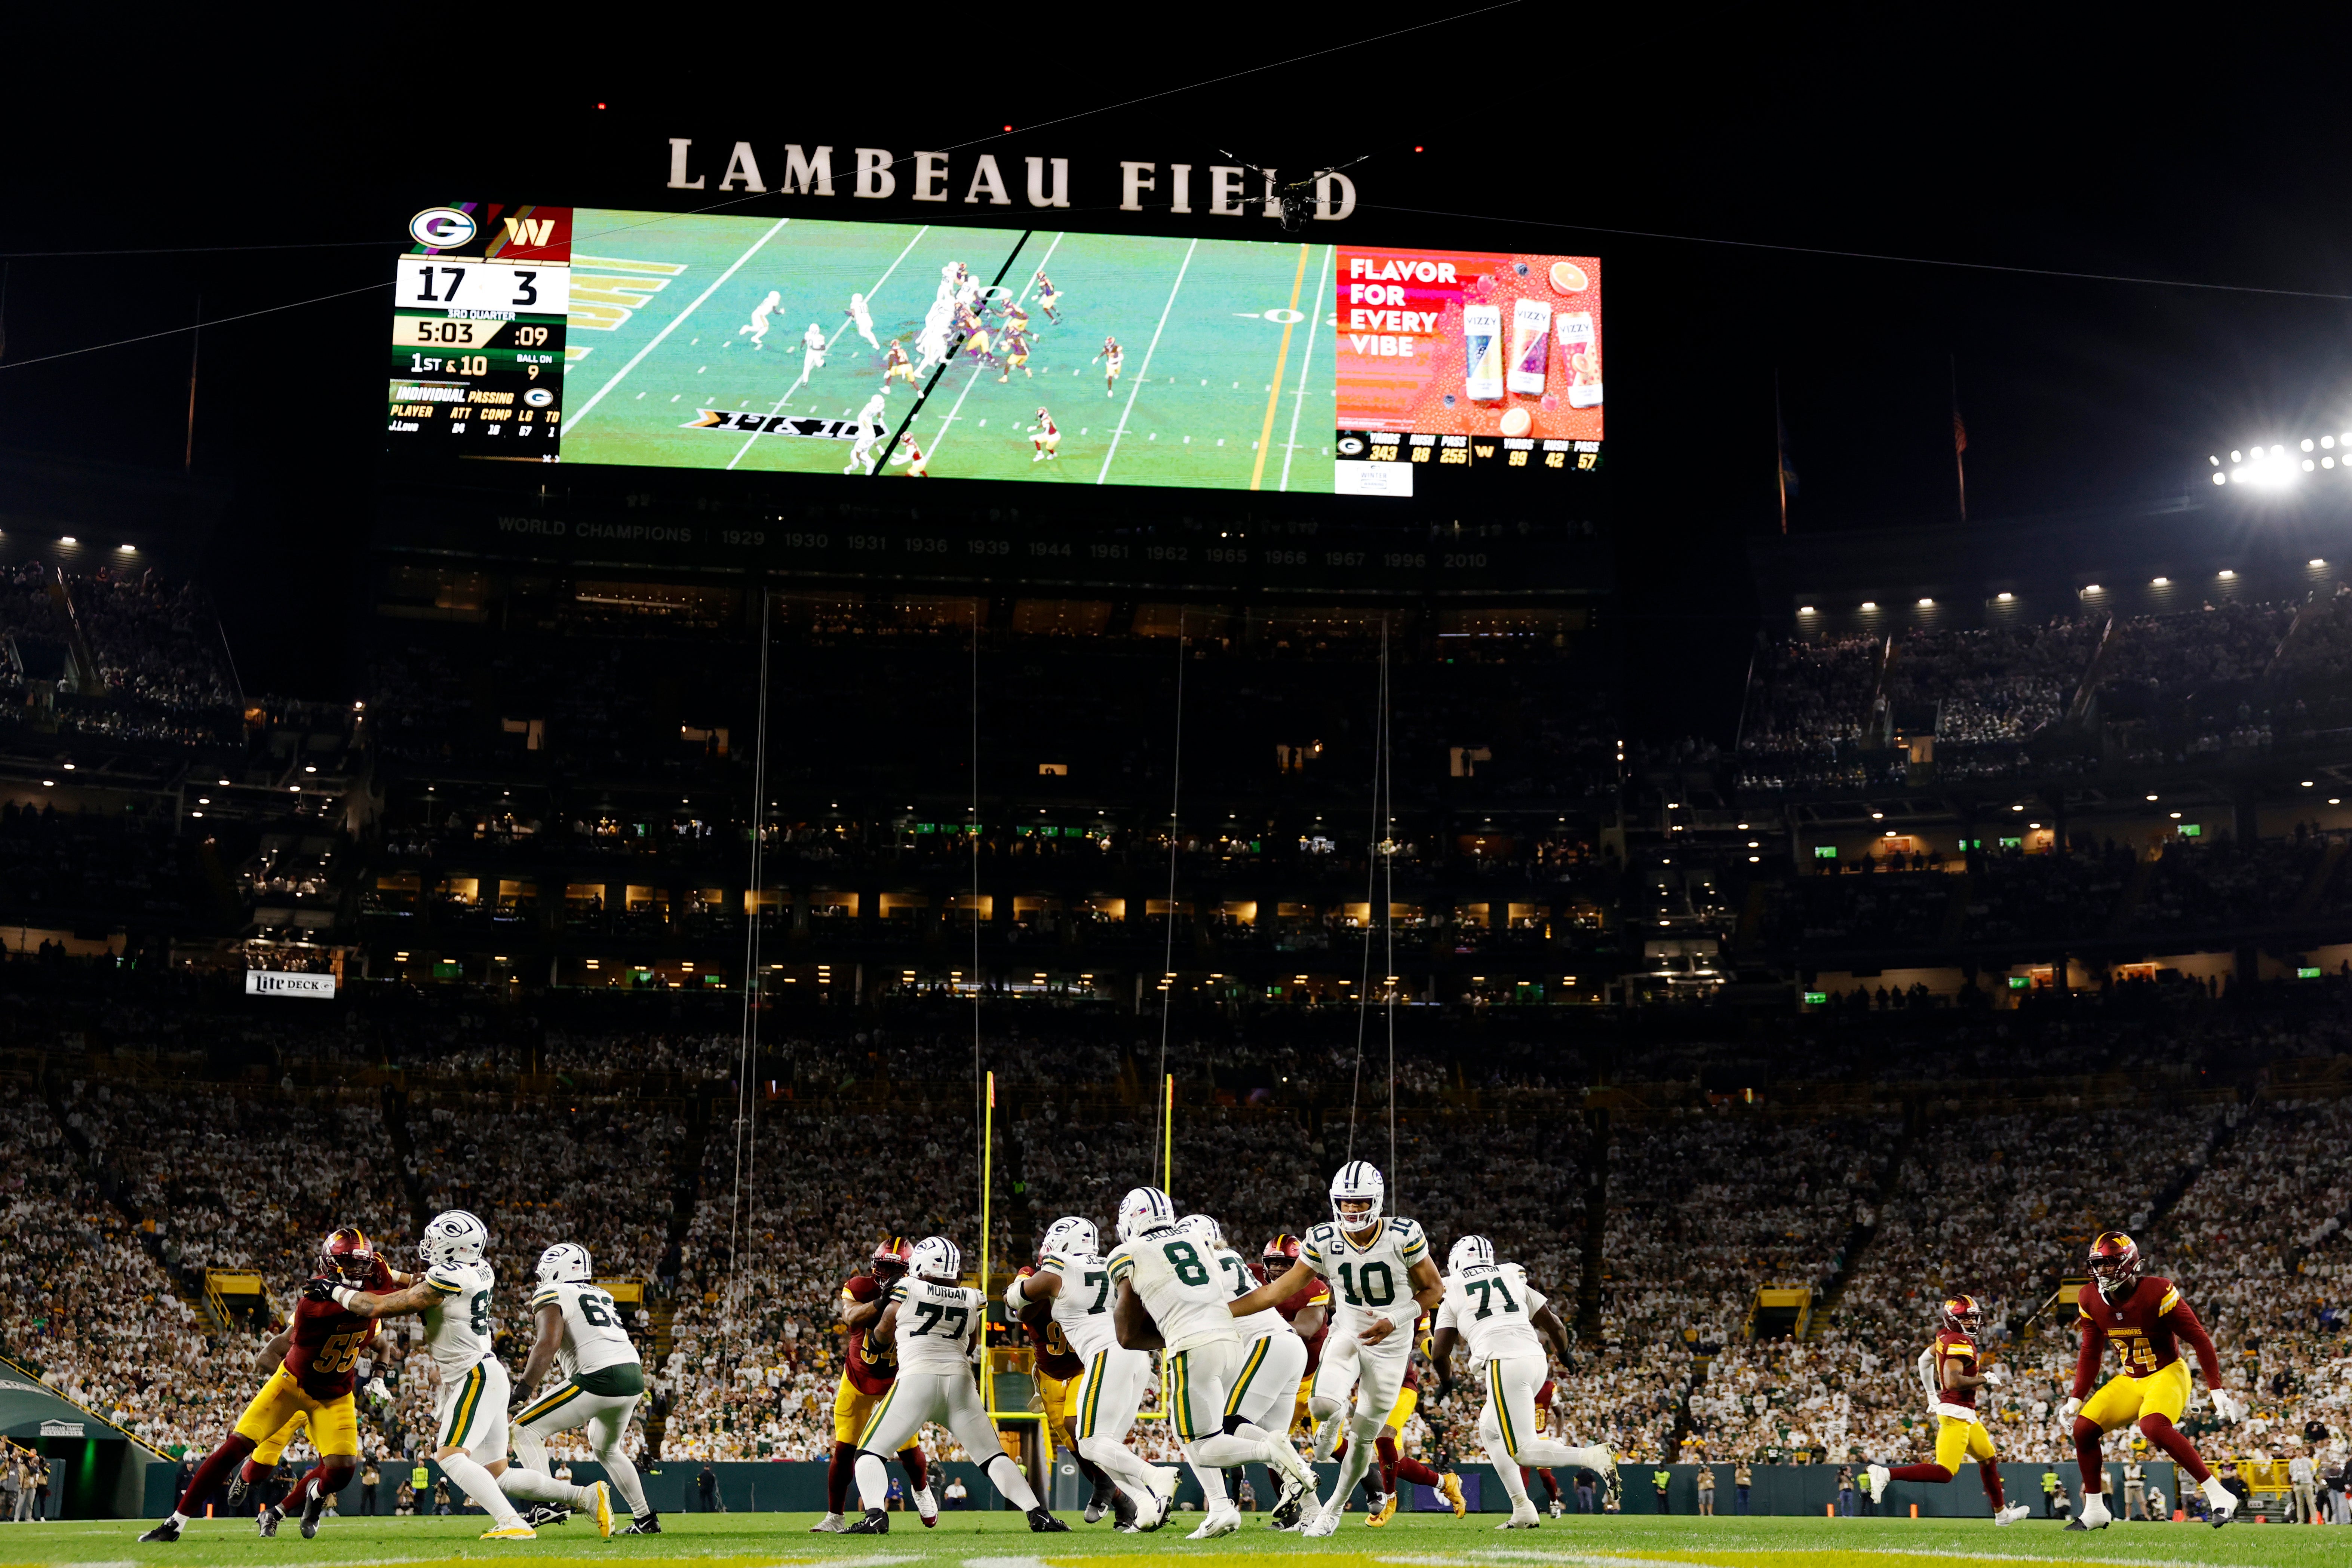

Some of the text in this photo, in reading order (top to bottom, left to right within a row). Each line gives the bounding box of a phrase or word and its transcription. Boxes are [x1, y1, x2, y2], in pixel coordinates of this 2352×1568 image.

[667, 138, 1357, 221] LAMBEAU FIELD
[1350, 258, 1457, 284] FLAVOR
[417, 267, 537, 305] 17 3
[1350, 283, 1406, 307] FOR
[448, 309, 516, 321] 3RD QUARTER
[1350, 308, 1438, 333] EVERY
[1466, 316, 1497, 326] VIZZY
[1517, 310, 1547, 322] VIZZY
[418, 322, 548, 347] 5:03 :09
[1560, 323, 1590, 333] VIZZY
[1349, 334, 1413, 357] VIBE
[411, 353, 487, 376] 1ST & 10
[517, 354, 552, 364] BALL ON
[528, 365, 539, 380] 9
[396, 386, 515, 405] INDIVIDUAL PASSING
[390, 404, 560, 423] PLAYER ATT COMP LG TD
[452, 423, 465, 434] 24
[548, 427, 555, 437] 1
[774, 417, 807, 435] &
[1370, 433, 1467, 448] YARDS RUSH PASS
[1503, 438, 1600, 453] YARDS RUSH PASS
[1370, 445, 1468, 464] 343 88 255
[1508, 451, 1597, 470] 99 42 57
[498, 516, 1487, 568] WORLD CHAMPIONS 1929 1930 1931 1936 1939 1944 1961 1962 1965 1966 1967 1996 2010
[256, 975, 285, 993] Lite
[287, 980, 319, 990] DECK
[1146, 1227, 1189, 1242] JACOBS
[1163, 1240, 1210, 1287] 8
[1461, 1266, 1499, 1278] BELTON
[927, 1284, 967, 1301] MORGAN
[1084, 1271, 1115, 1315] 7
[1338, 1261, 1395, 1307] 10
[1465, 1277, 1520, 1321] 71
[578, 1294, 623, 1329] 63
[910, 1301, 968, 1340] 77
[1046, 1321, 1076, 1356] 9
[313, 1329, 368, 1373] 55
[2110, 1338, 2157, 1374] 24
